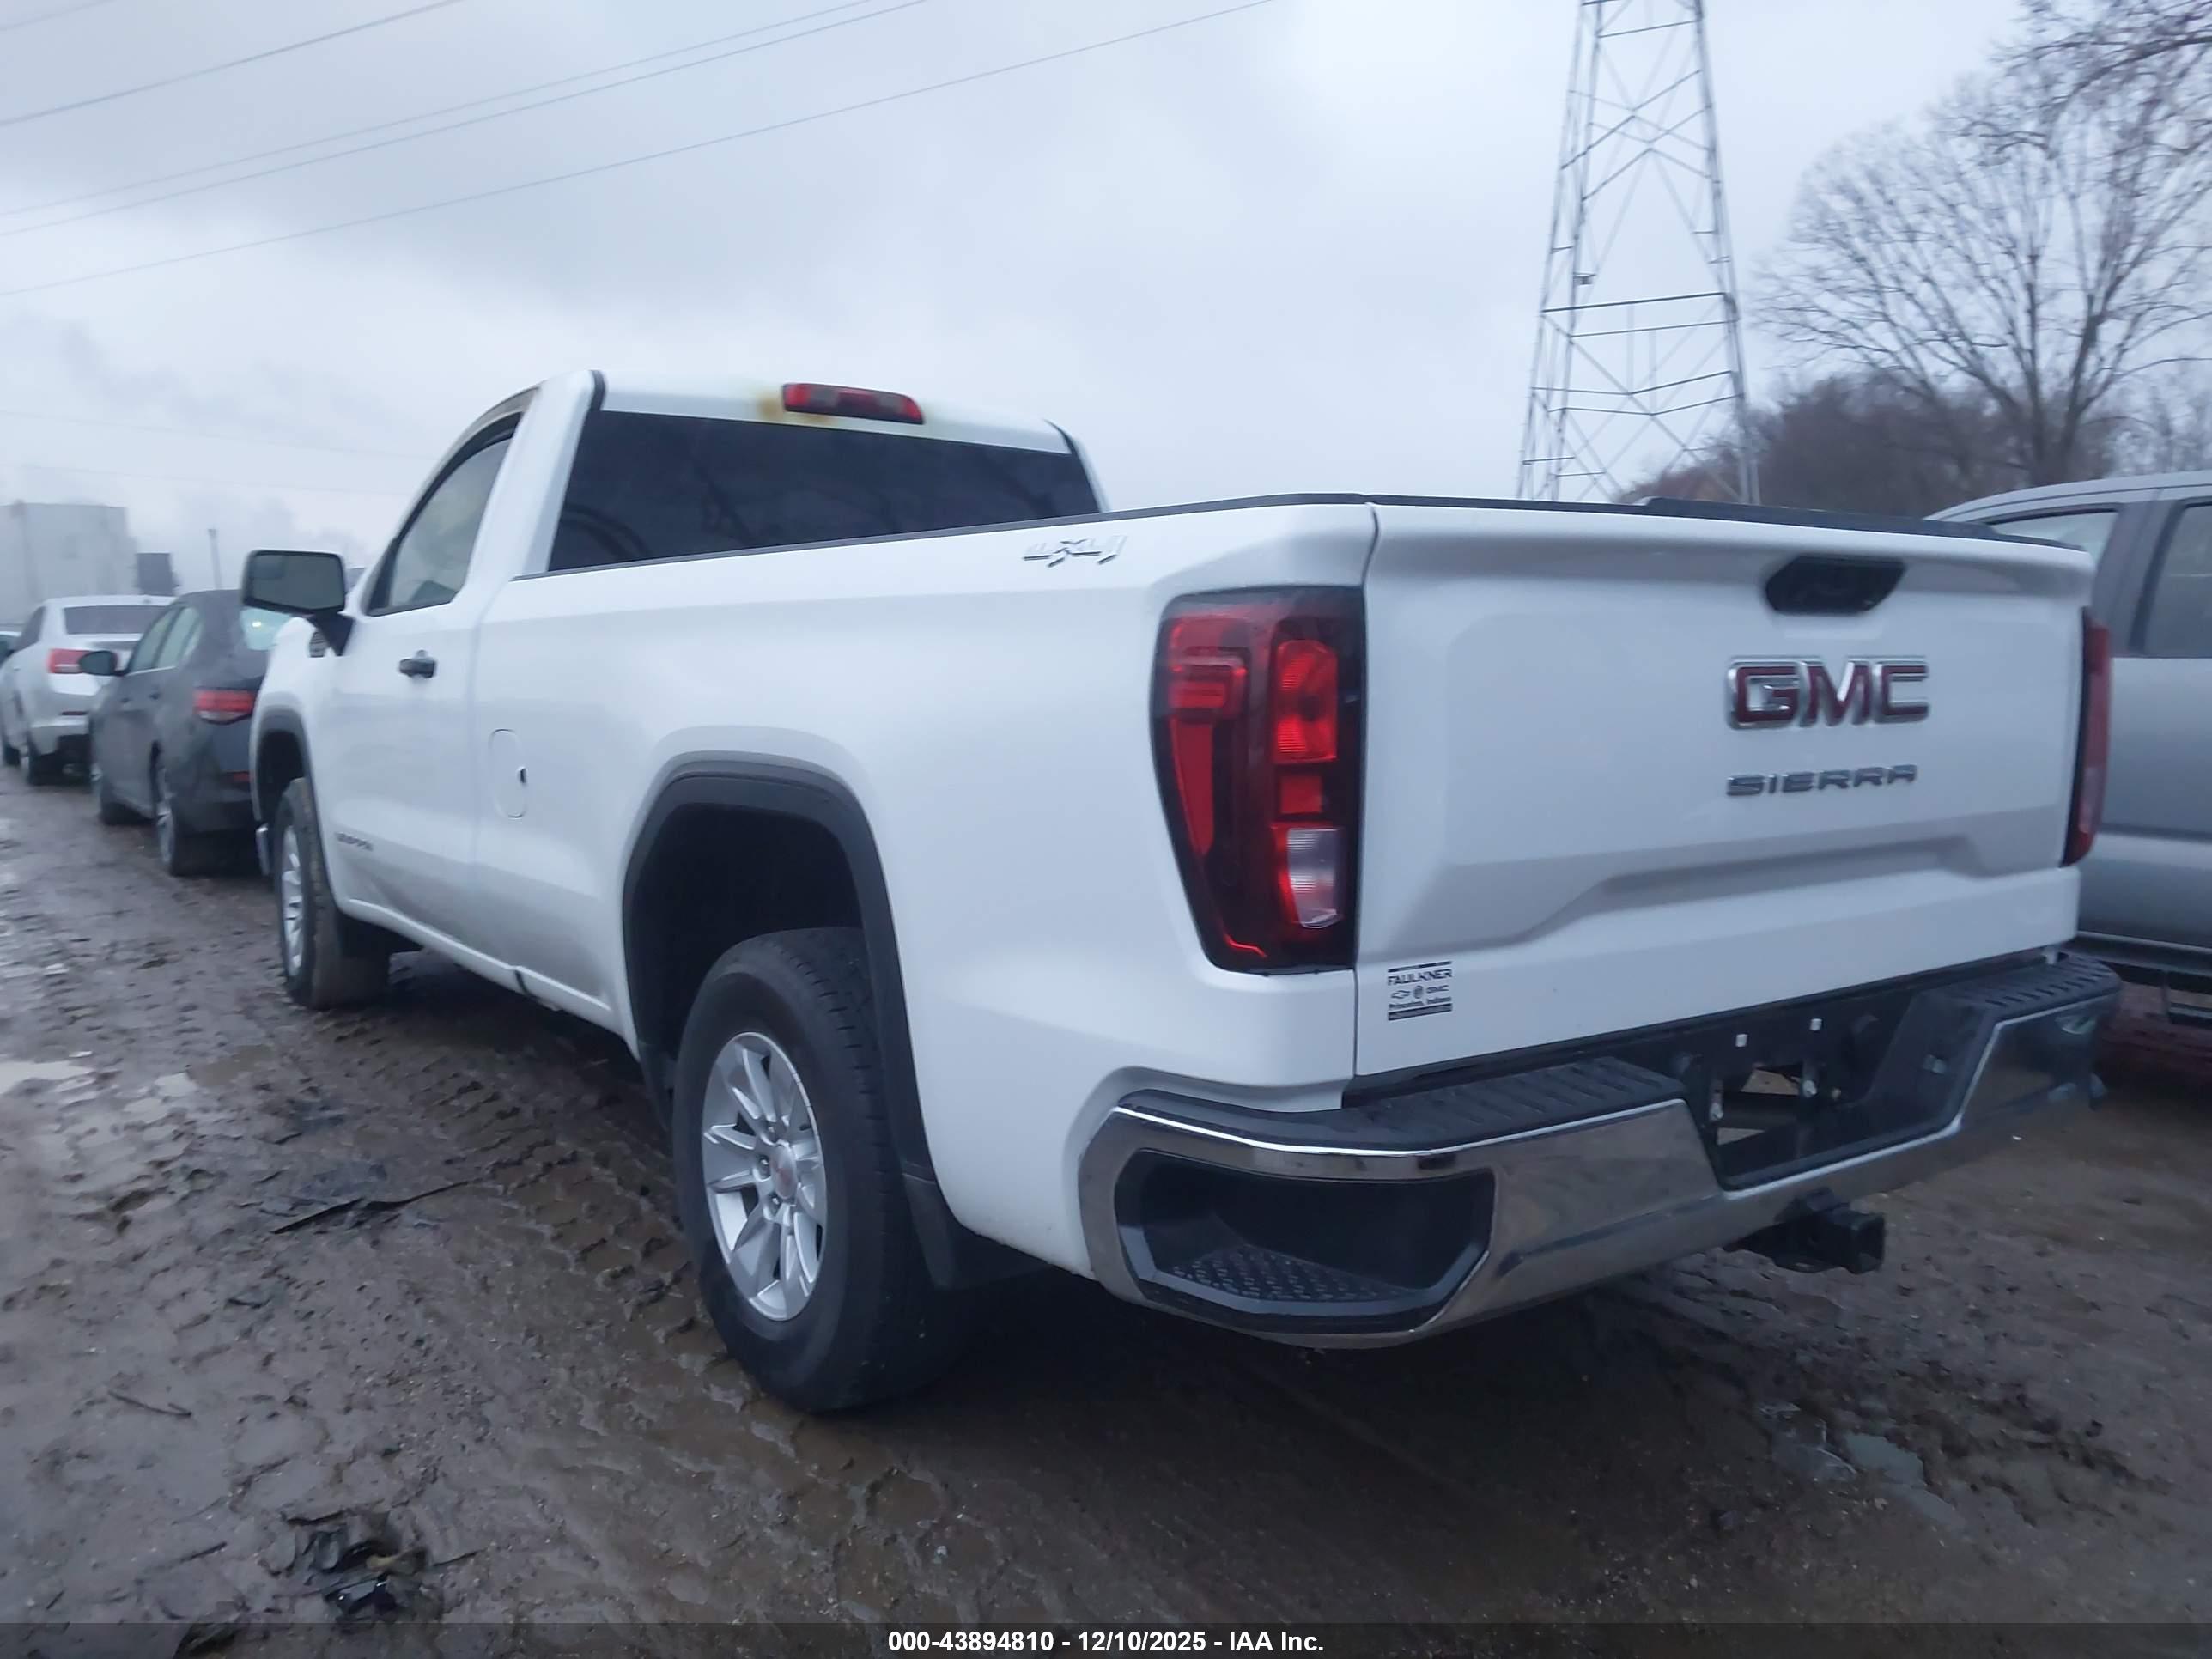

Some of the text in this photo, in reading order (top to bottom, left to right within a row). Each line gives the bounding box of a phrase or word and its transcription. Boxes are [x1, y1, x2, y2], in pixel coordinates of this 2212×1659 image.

[1725, 655, 1929, 729] GMC
[1726, 764, 1917, 796] SIERRA
[1387, 967, 1452, 986] FAULKNER
